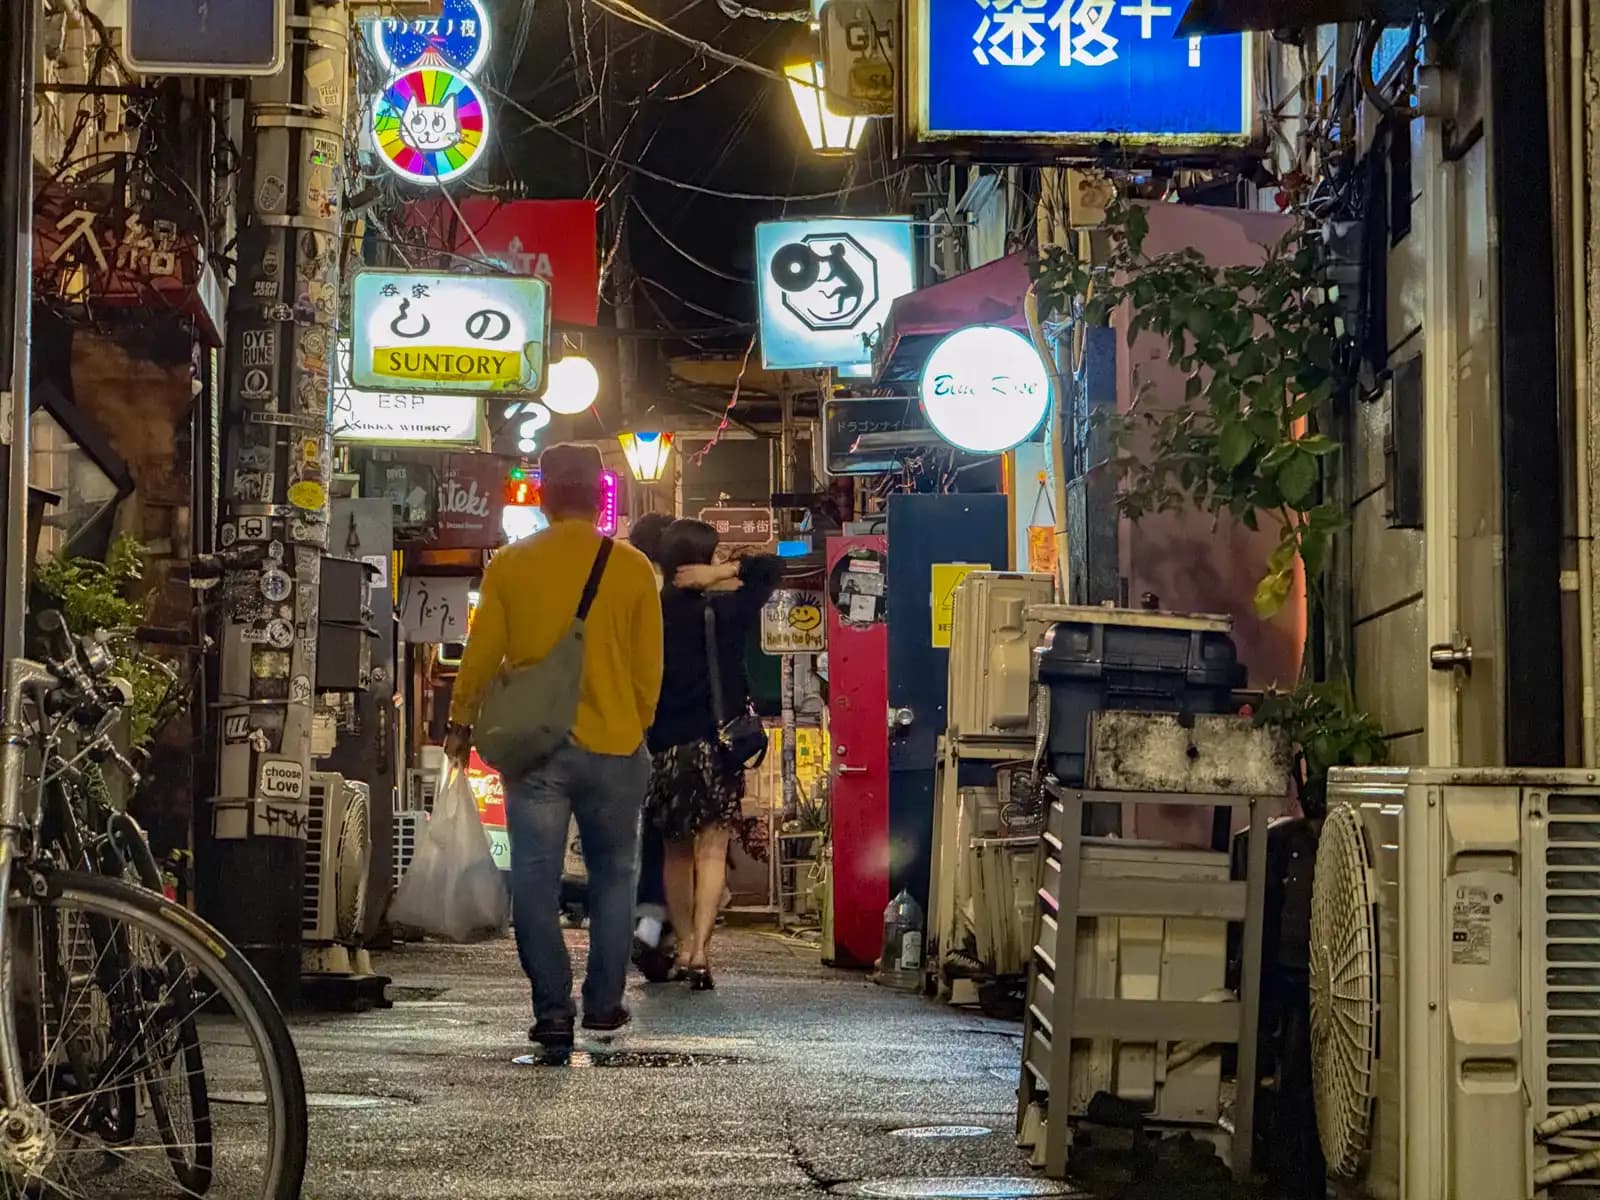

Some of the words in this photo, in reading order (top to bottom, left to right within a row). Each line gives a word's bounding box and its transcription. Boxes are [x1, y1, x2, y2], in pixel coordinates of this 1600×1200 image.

[243, 332, 273, 347] OYE
[243, 347, 273, 365] RUNS
[389, 351, 506, 375] SUNTORY
[378, 394, 425, 409] ESP
[265, 765, 301, 780] choose
[266, 780, 299, 794] Love
